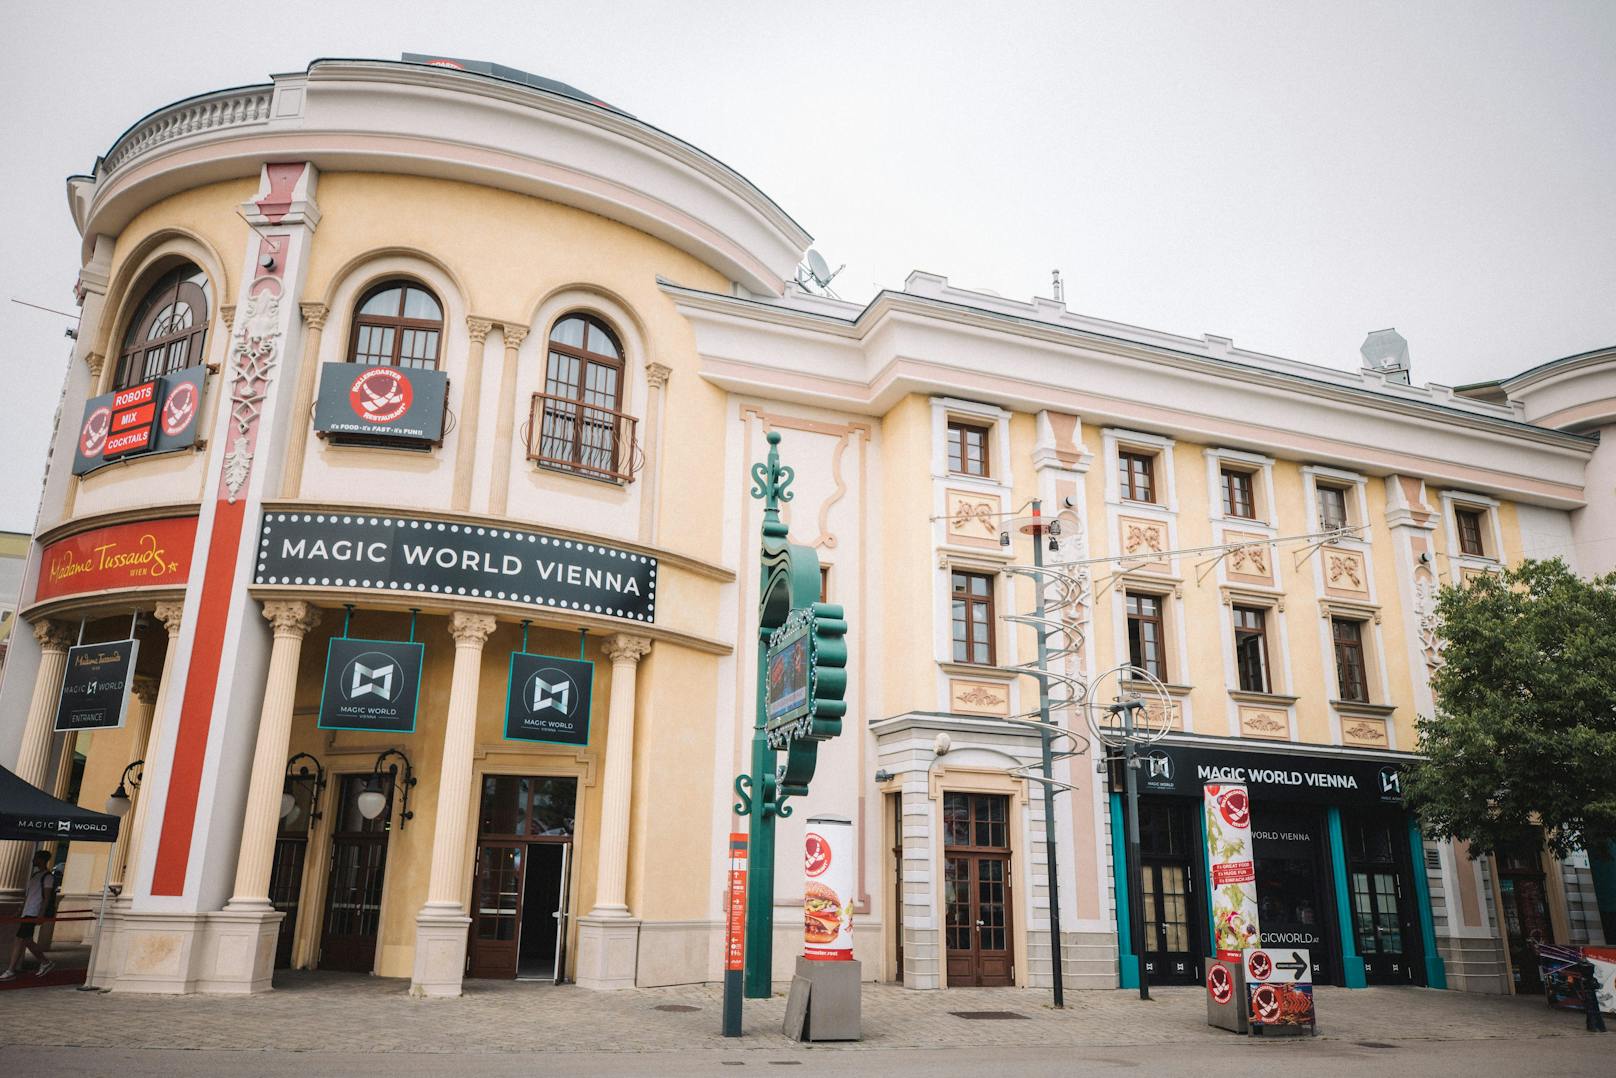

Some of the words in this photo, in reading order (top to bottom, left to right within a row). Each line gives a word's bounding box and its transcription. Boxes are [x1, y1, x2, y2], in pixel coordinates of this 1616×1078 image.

[115, 386, 152, 407] ROBOTS
[121, 411, 138, 426] MIX
[107, 431, 149, 449] COCKTAILS
[49, 550, 95, 584] Madame
[94, 534, 166, 577] Tussauds
[129, 567, 148, 577] WIEN
[280, 538, 388, 563] MAGIC
[403, 544, 523, 576] WORLD
[536, 559, 641, 597] VIENNA
[64, 685, 87, 695] MAGIC
[98, 681, 124, 691] WORLD
[71, 712, 103, 723] ENTRANCE
[340, 706, 366, 714] MAGIC
[367, 708, 397, 716] WORLD
[524, 719, 547, 727] MAGIC
[548, 721, 574, 729] WORLD
[1197, 765, 1246, 780] MAGIC
[1248, 768, 1303, 786] WORLD
[1303, 772, 1359, 789] VIENNA
[18, 820, 54, 829] MAGIC
[74, 823, 108, 832] WORLD
[1280, 832, 1310, 841] VIENNA
